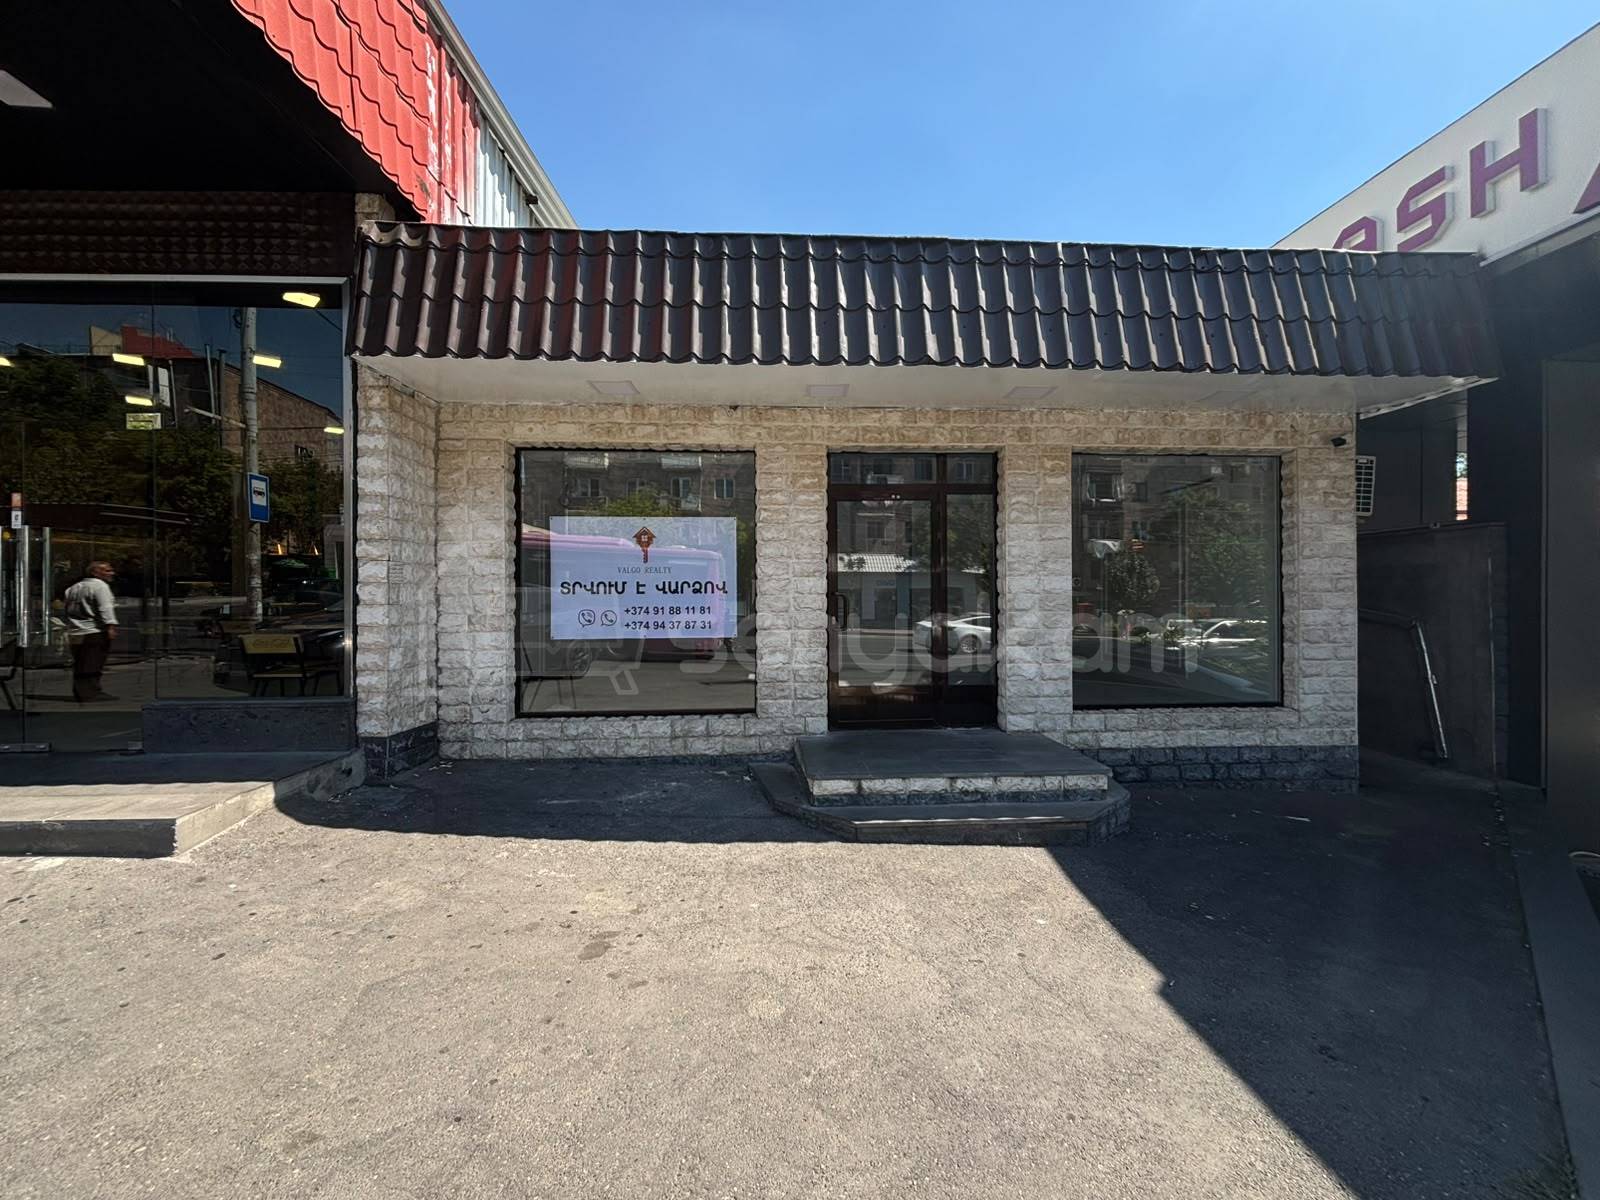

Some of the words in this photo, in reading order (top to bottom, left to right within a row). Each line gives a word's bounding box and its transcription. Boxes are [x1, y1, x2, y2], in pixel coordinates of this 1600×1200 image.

[617, 566, 641, 574] VALGO
[644, 566, 673, 574] REALTY
[560, 581, 627, 595] ՏՐՎՈՒՄ
[636, 581, 646, 595] Է
[655, 581, 728, 595] ՎԱՐՁՈՎ
[624, 606, 650, 616] +374
[653, 606, 665, 616] 91
[668, 606, 681, 616] 88
[685, 606, 695, 616] 11
[699, 606, 711, 616] 81
[624, 620, 650, 630] +374
[653, 620, 665, 630] 94
[668, 620, 682, 630] 37
[684, 620, 697, 630] 87
[700, 620, 712, 630] 31
